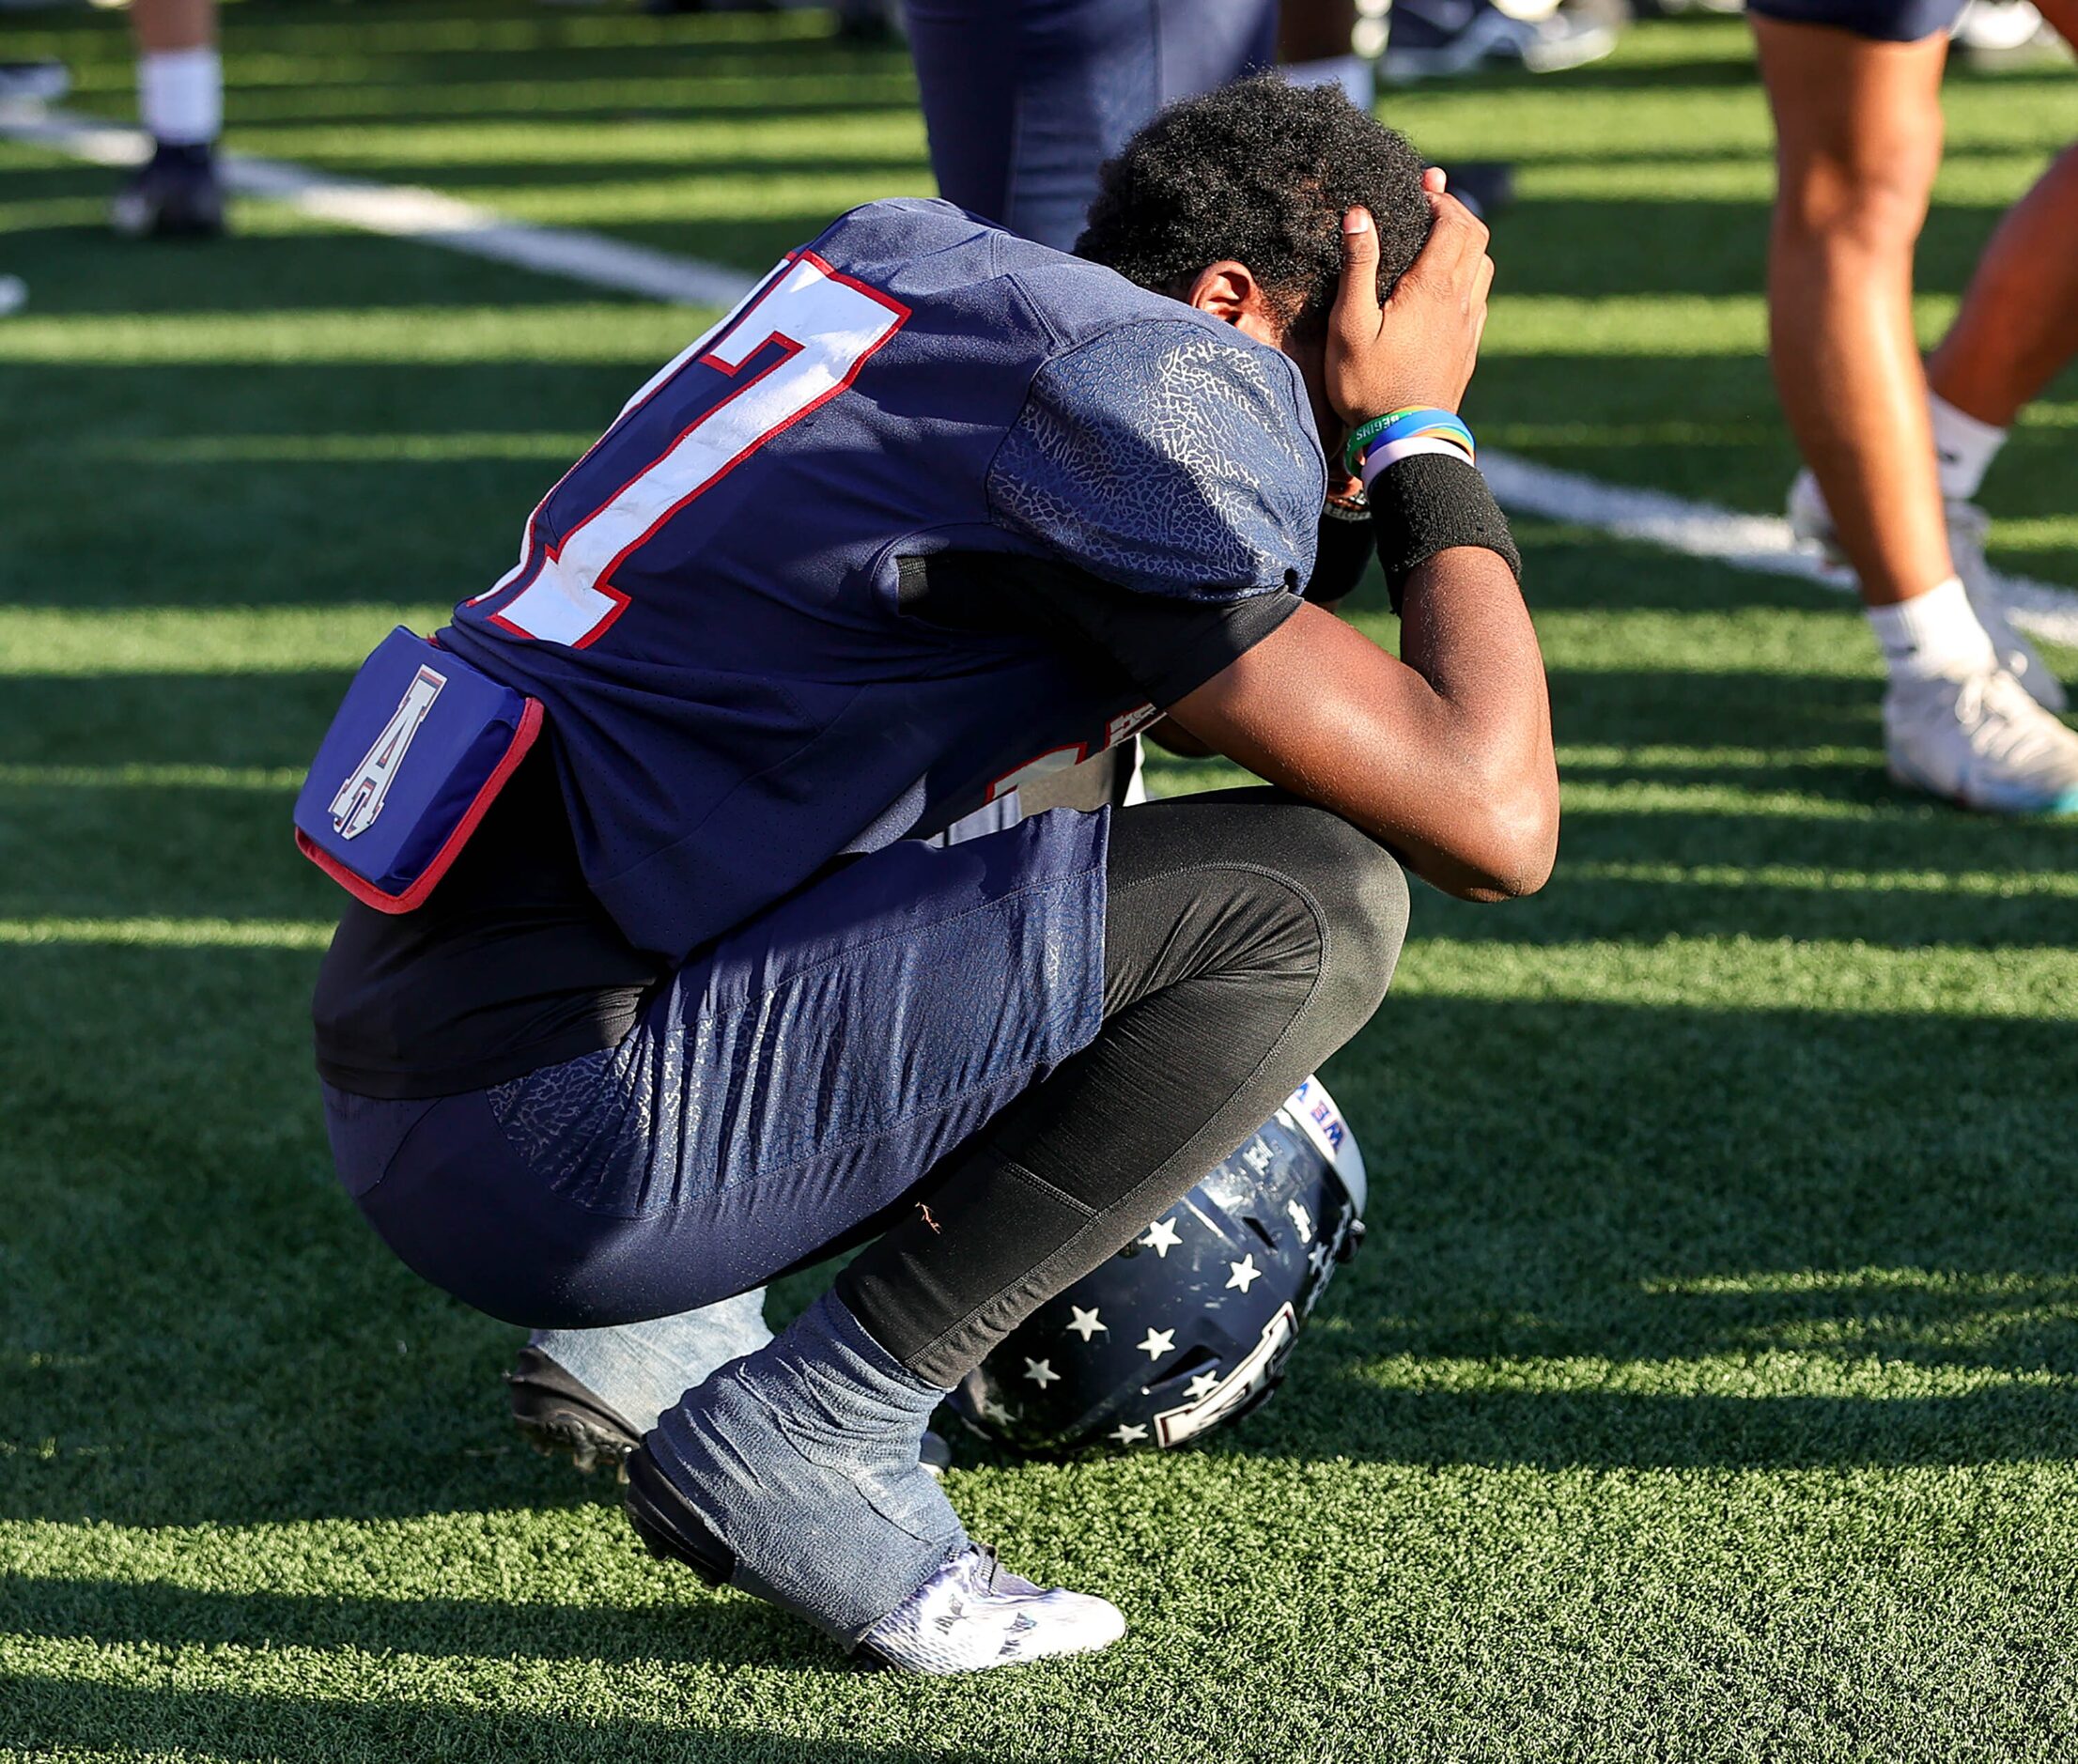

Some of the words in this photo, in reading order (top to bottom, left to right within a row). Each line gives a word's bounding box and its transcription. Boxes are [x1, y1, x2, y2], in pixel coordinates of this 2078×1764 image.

[467, 251, 912, 649] 7
[329, 663, 447, 840] A
[1310, 1099, 1345, 1154] WE
